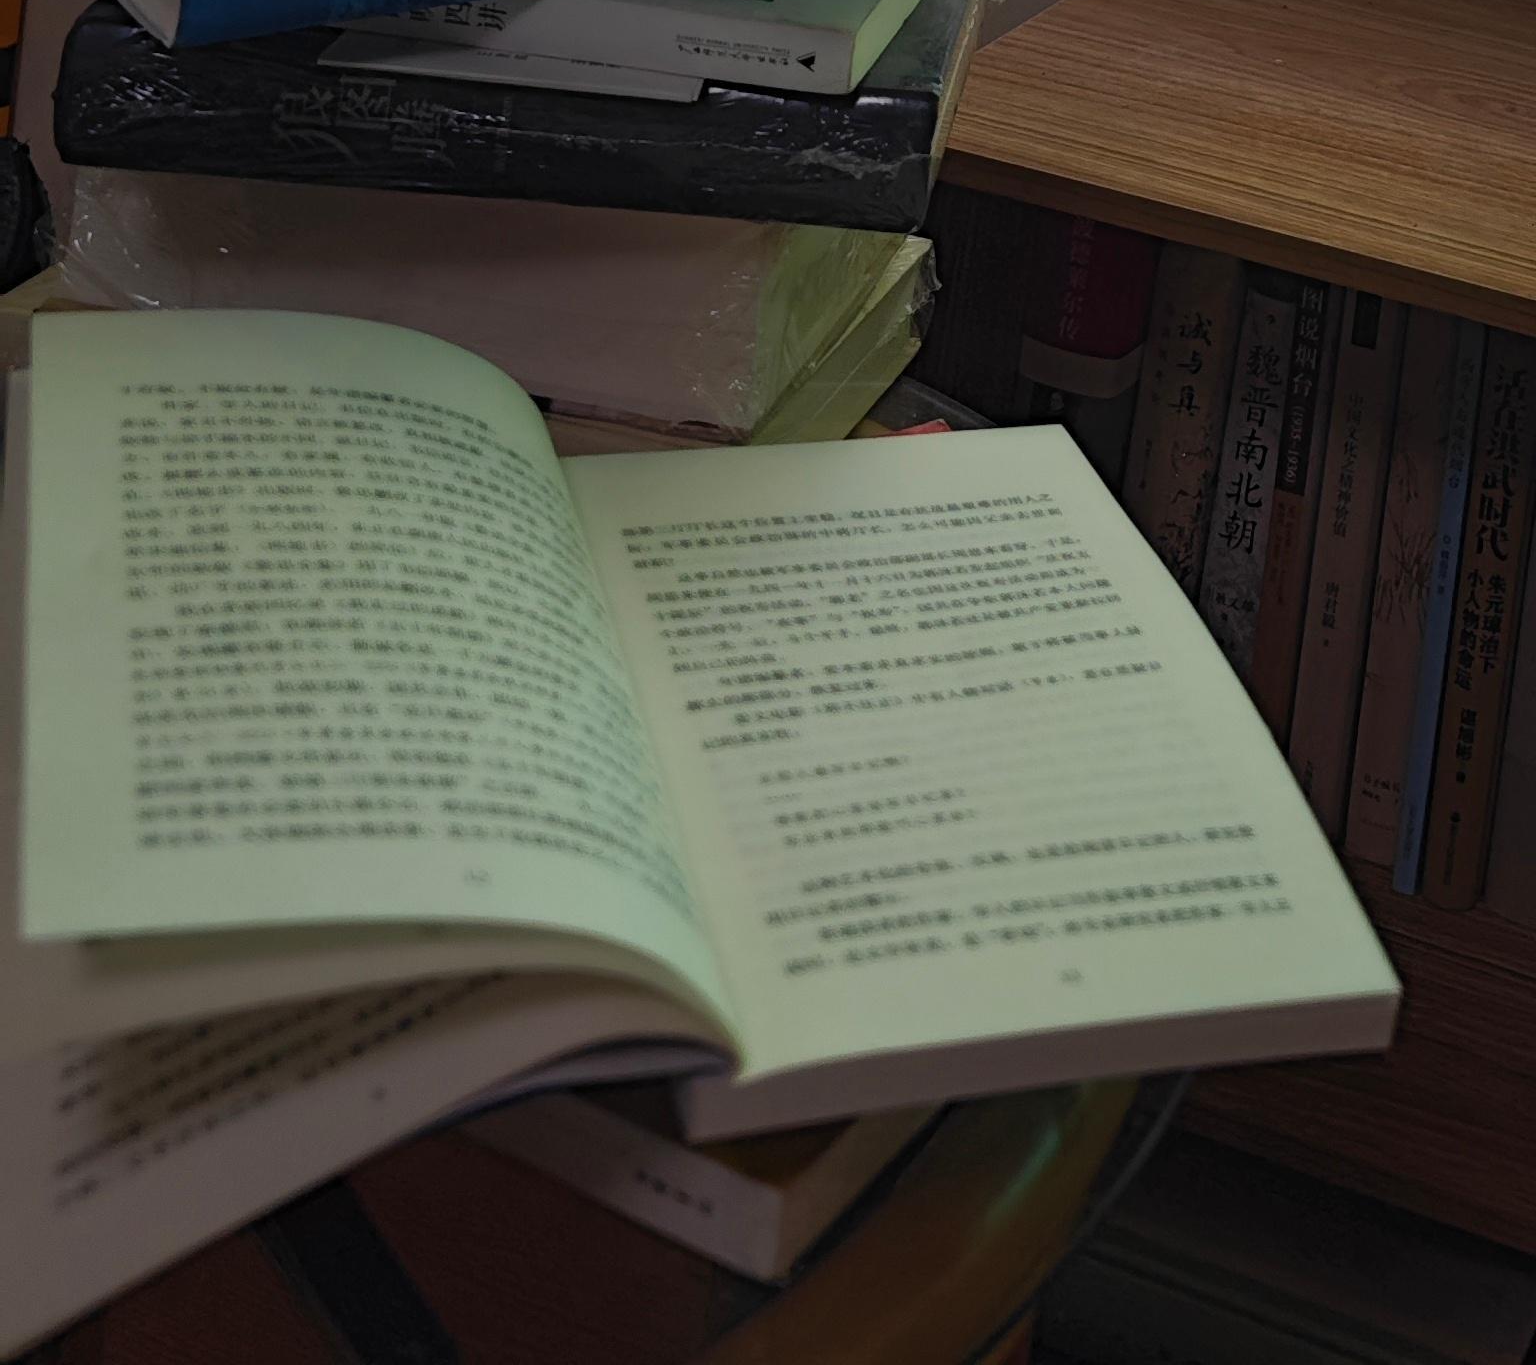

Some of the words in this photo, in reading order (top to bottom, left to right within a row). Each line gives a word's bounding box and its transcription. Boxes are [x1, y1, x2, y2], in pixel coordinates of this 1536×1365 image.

[1218, 343, 1283, 555] 魏晋南北朝
